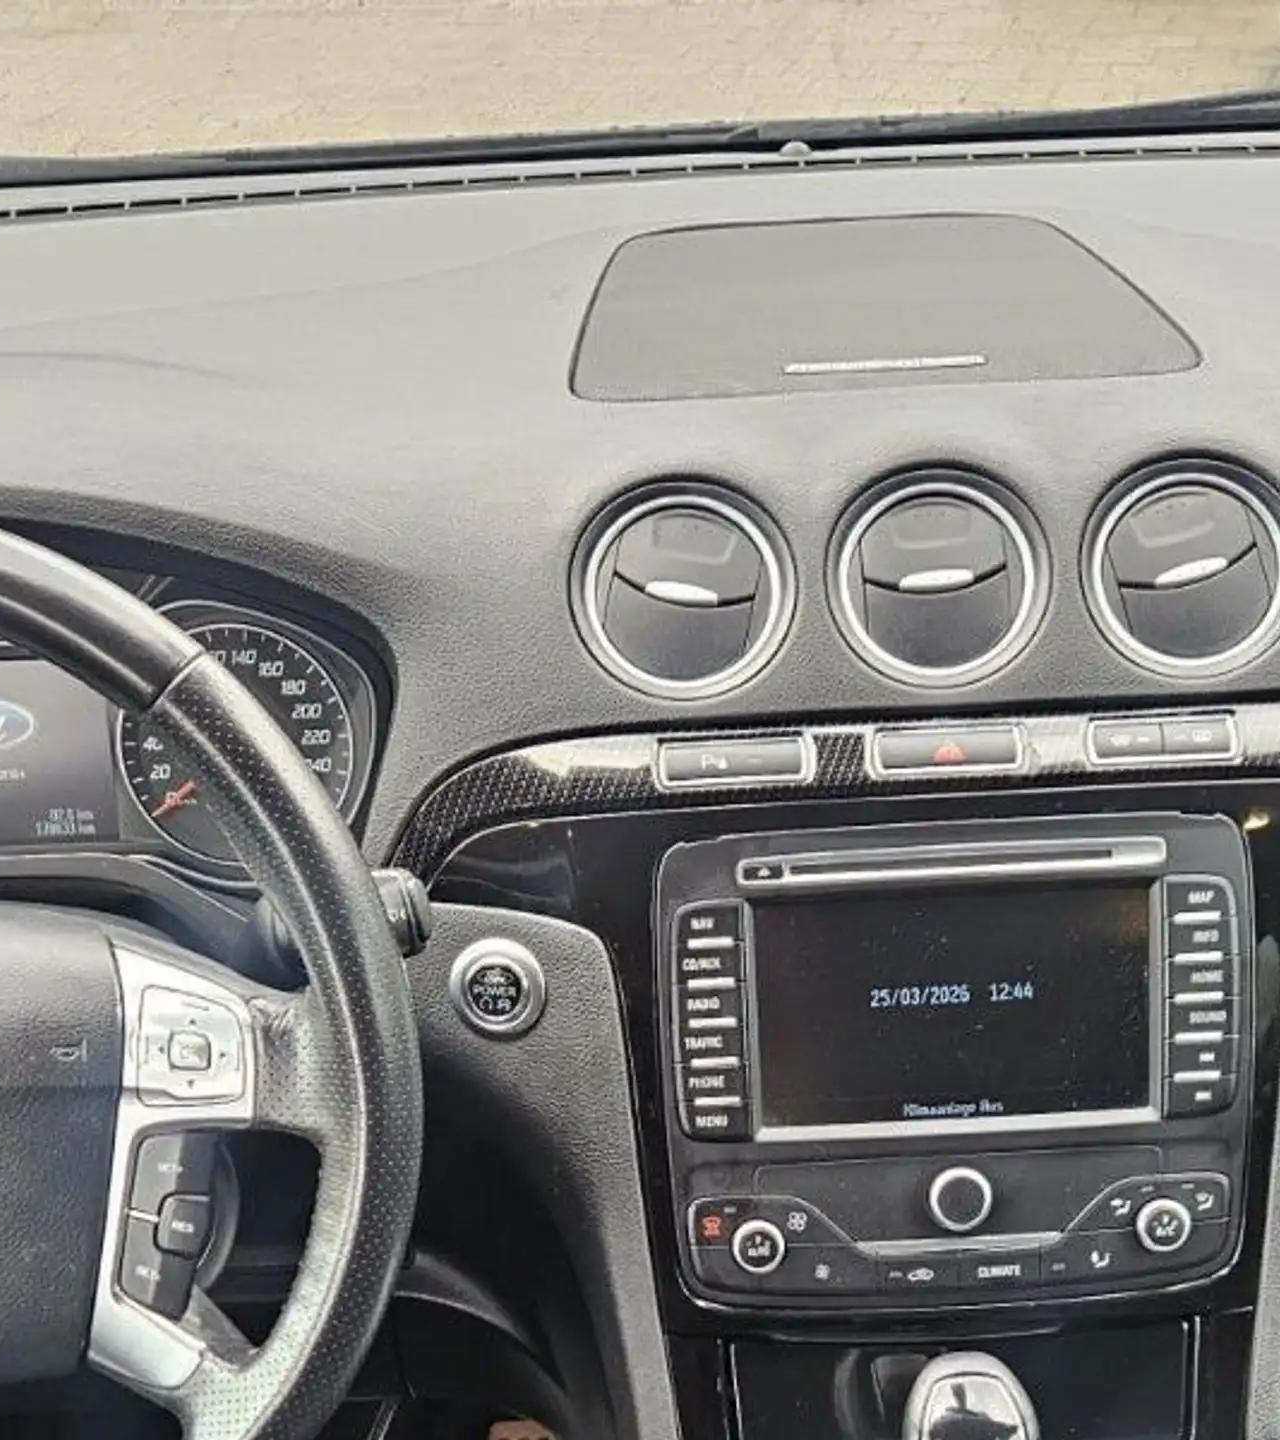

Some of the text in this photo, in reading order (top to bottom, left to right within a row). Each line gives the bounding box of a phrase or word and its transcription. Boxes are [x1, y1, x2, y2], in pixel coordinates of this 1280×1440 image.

[232, 649, 257, 664] 140
[258, 661, 283, 677] 160
[280, 680, 306, 695] 180
[291, 704, 322, 719] 200
[301, 729, 331, 745] 220
[150, 763, 171, 780] 20
[1188, 890, 1215, 904] MAP
[690, 917, 715, 930] NAV
[1192, 929, 1219, 943] INFO
[870, 981, 1034, 1008] 25/03/2026 12:44
[687, 996, 720, 1011] RADIO
[1188, 1010, 1227, 1024] SOUND
[684, 1036, 723, 1050] TRAFFIC
[688, 1075, 725, 1089] PHONE
[695, 1114, 729, 1129] MENU
[977, 1264, 1021, 1279] CLIMATE
